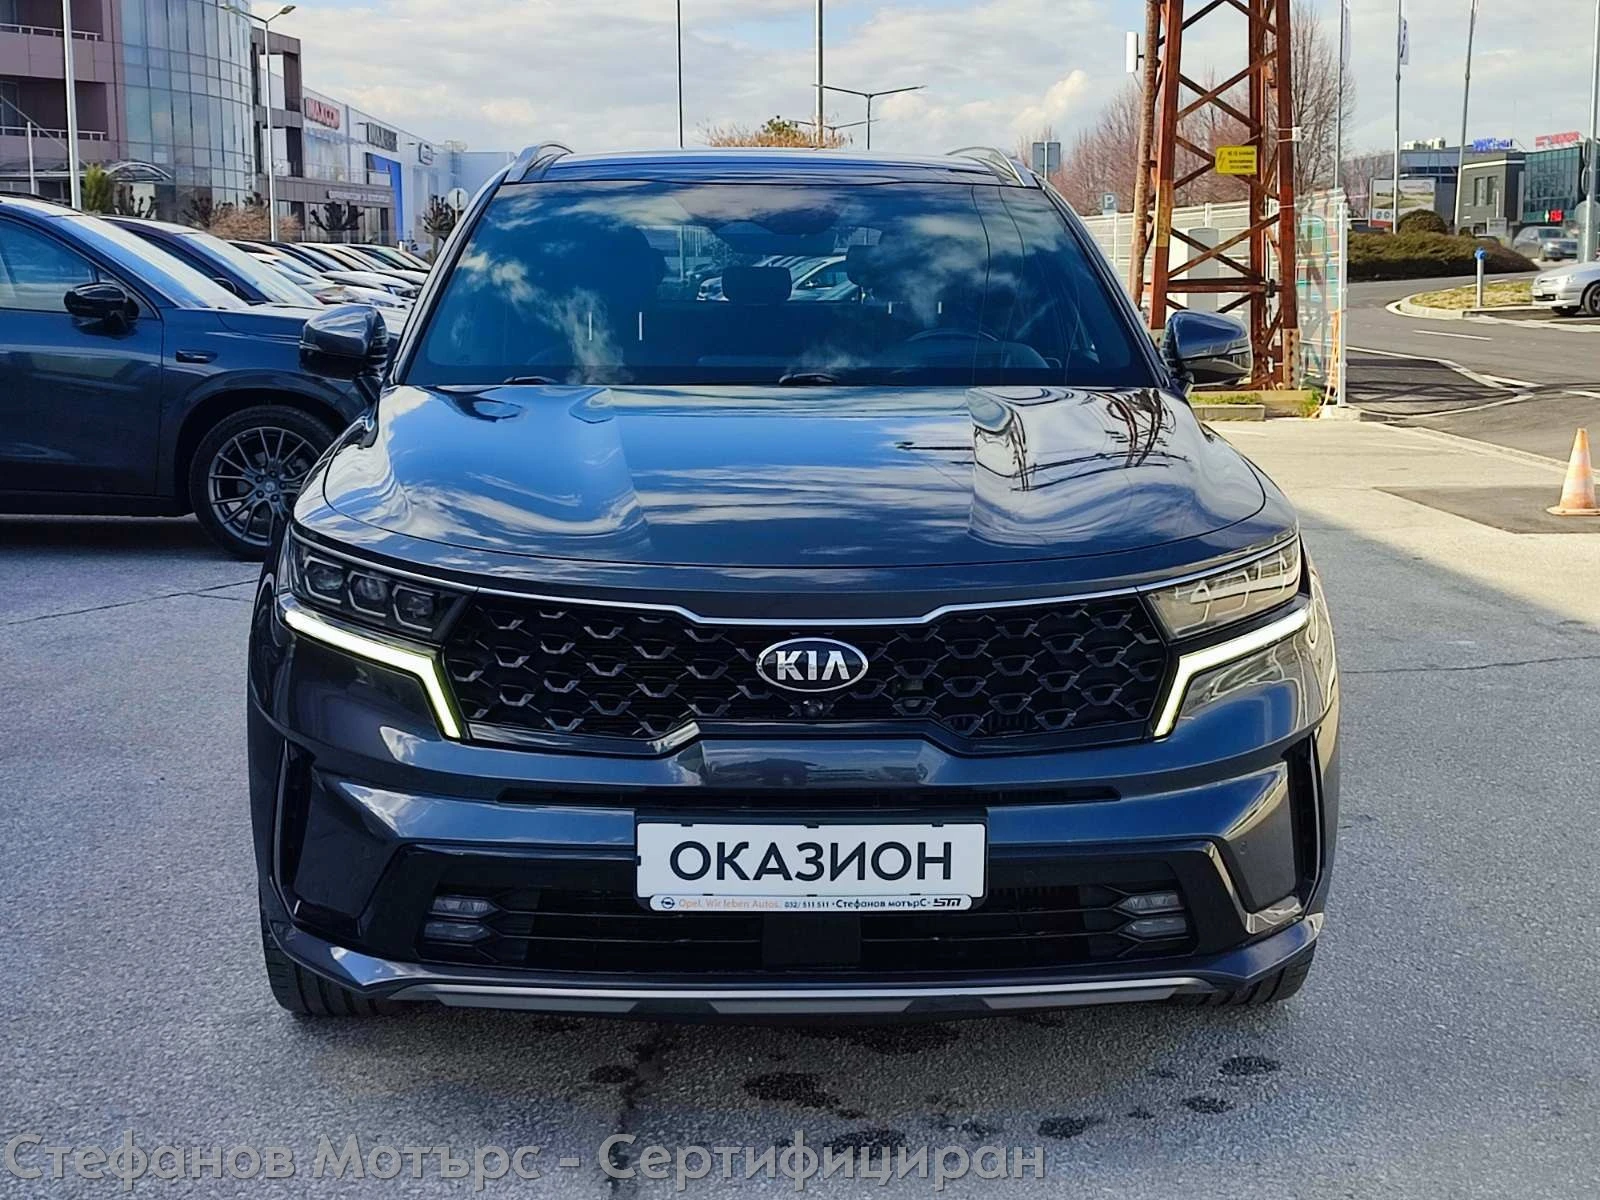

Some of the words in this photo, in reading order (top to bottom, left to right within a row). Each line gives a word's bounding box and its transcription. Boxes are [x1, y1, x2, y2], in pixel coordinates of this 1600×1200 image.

[1104, 195, 1114, 208] P
[776, 650, 850, 680] KIA
[670, 841, 952, 882] ОКАЗИОН
[706, 899, 721, 908] Wir
[724, 899, 749, 908] leben
